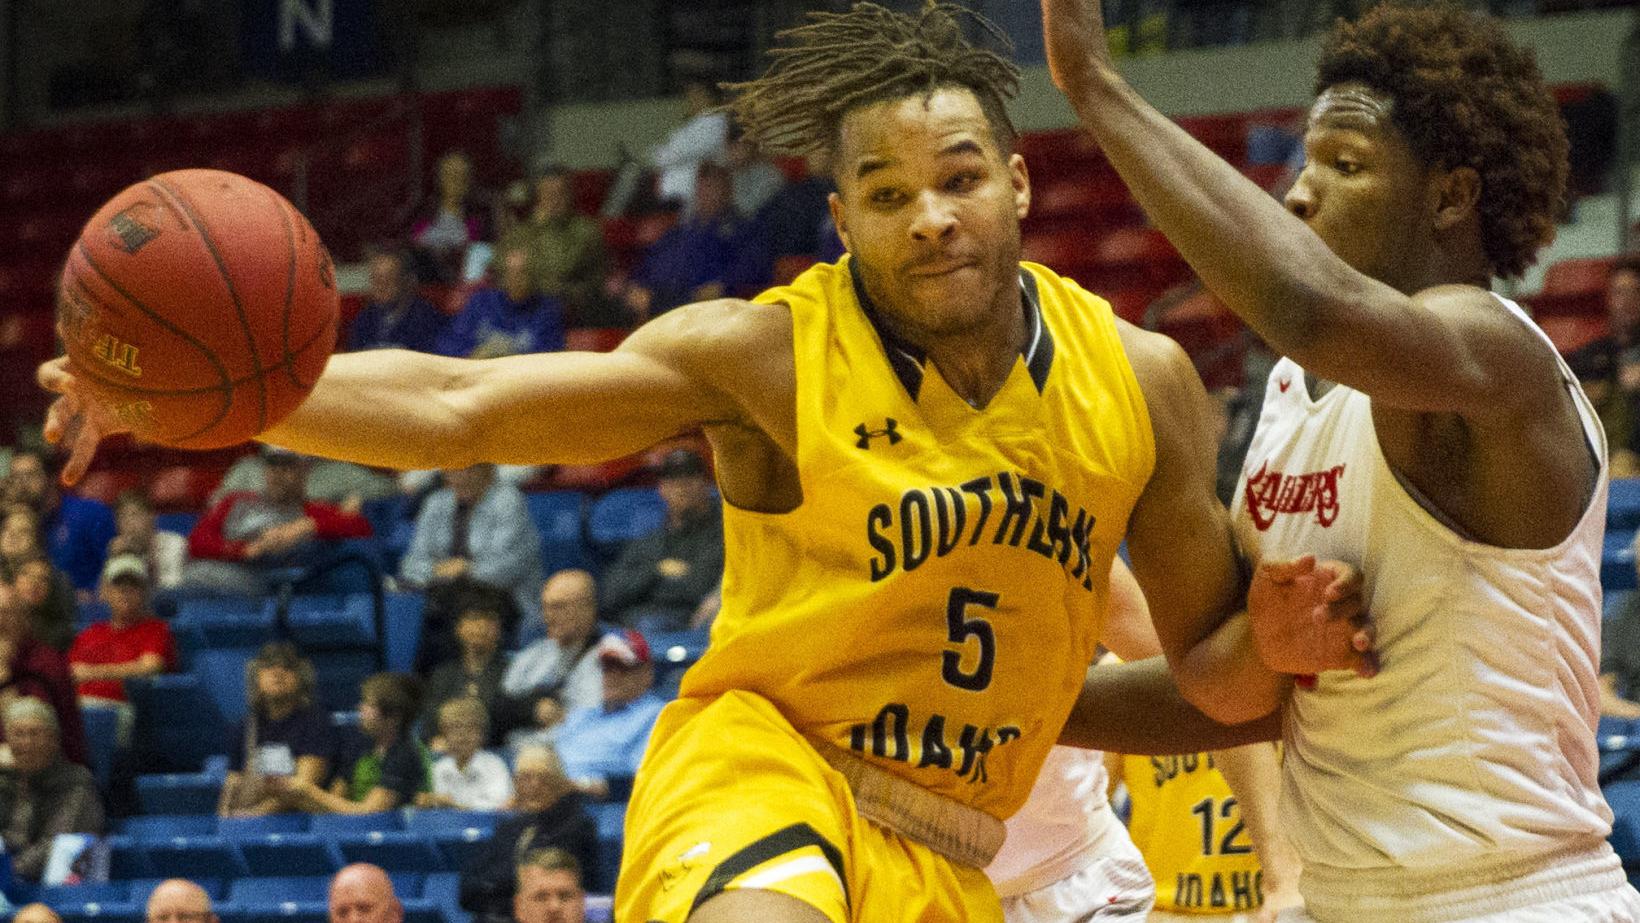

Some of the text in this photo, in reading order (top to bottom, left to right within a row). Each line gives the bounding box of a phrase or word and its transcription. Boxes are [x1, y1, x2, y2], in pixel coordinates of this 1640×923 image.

[867, 471, 1097, 592] SOUTHERN
[941, 586, 999, 692] 5
[1192, 797, 1253, 856] 12
